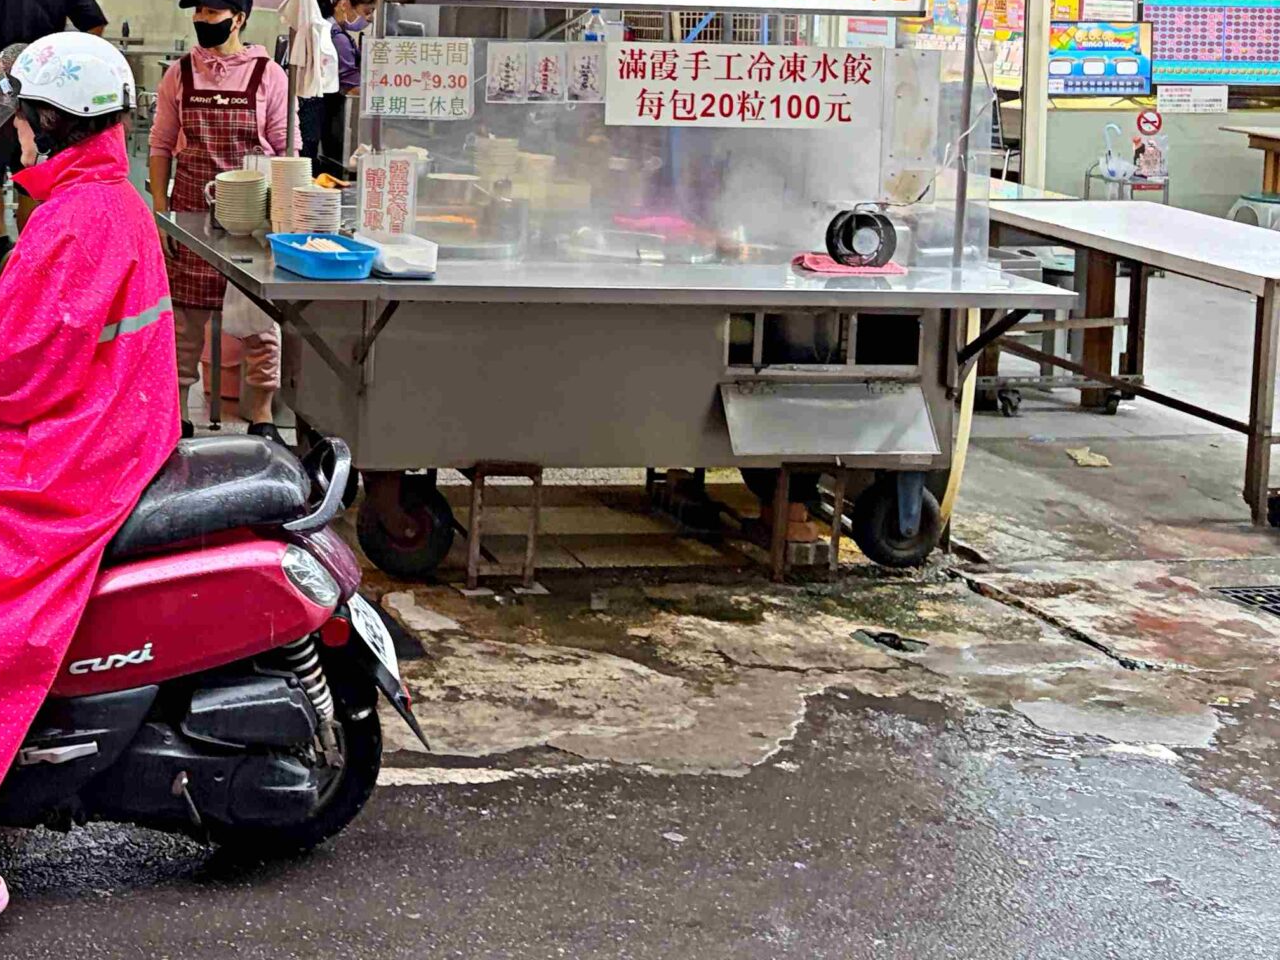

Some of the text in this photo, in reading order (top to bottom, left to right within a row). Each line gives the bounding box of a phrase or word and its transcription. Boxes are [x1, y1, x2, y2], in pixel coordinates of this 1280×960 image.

[369, 41, 469, 67] 營業時間
[617, 48, 873, 85] 滿霞手工冷凍水餃
[370, 95, 468, 116] 星期三休息
[635, 87, 853, 123] 每包20粒100元
